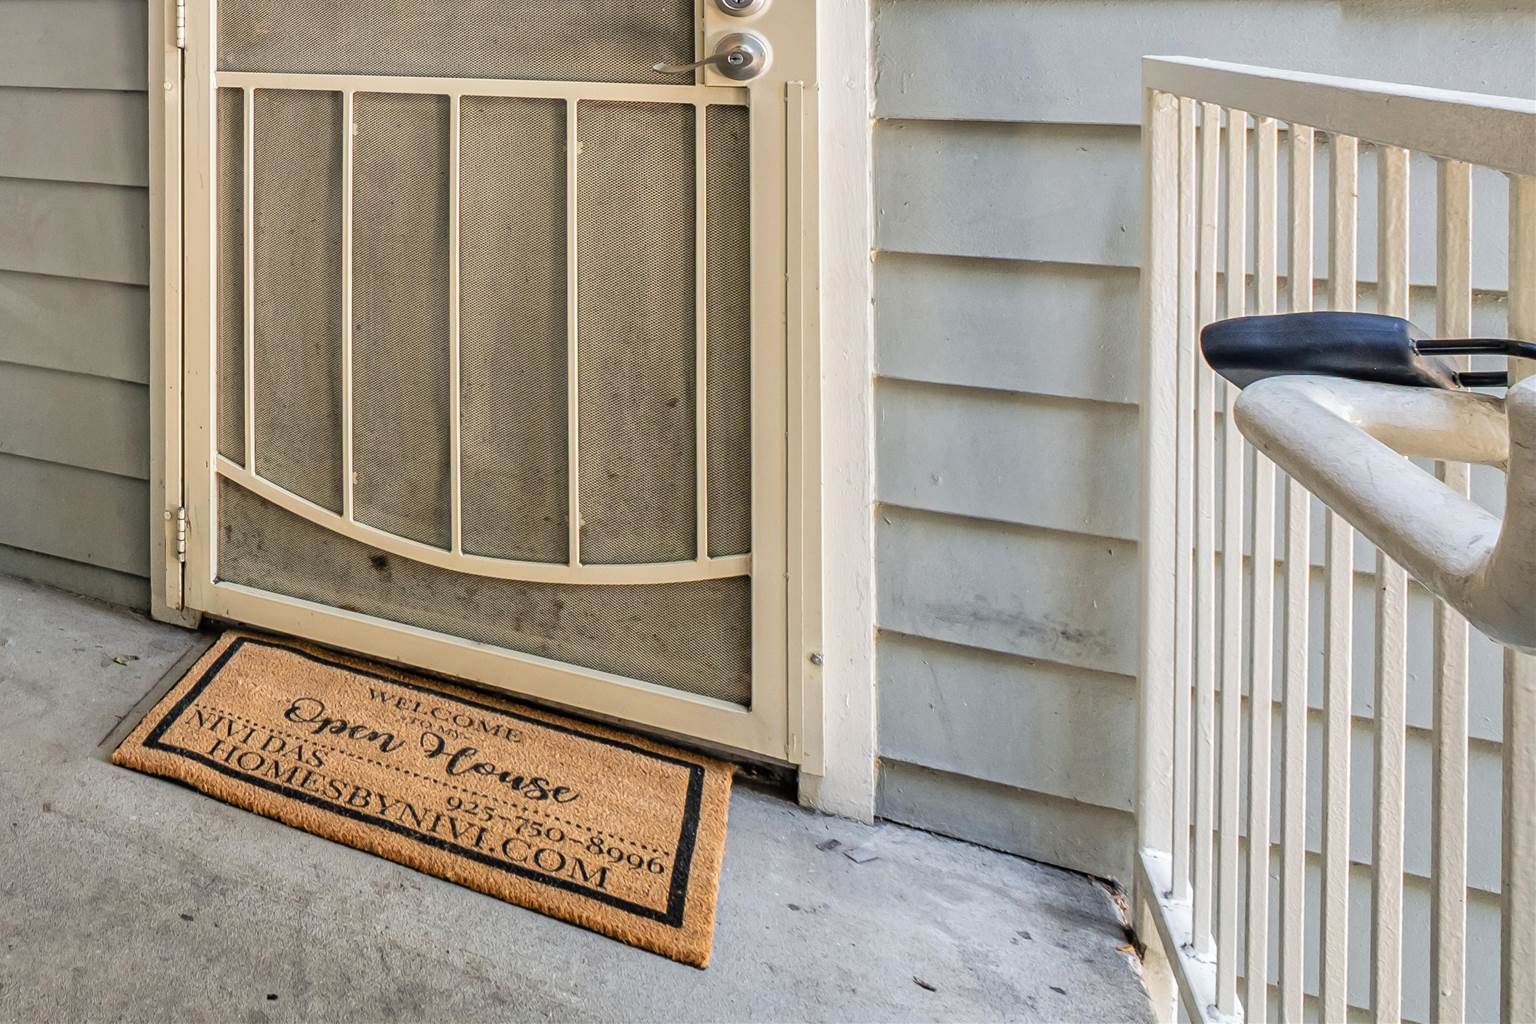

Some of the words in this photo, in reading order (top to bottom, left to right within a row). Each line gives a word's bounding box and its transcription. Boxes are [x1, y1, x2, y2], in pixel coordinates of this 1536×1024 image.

[185, 708, 255, 744] NIVI
[260, 734, 328, 769] DAS
[284, 696, 406, 754] Open
[420, 731, 579, 803] House
[368, 687, 522, 744] WELCOME
[207, 738, 610, 890] HOMESBYNIVI.COM
[446, 795, 665, 875] 925-750-8996
